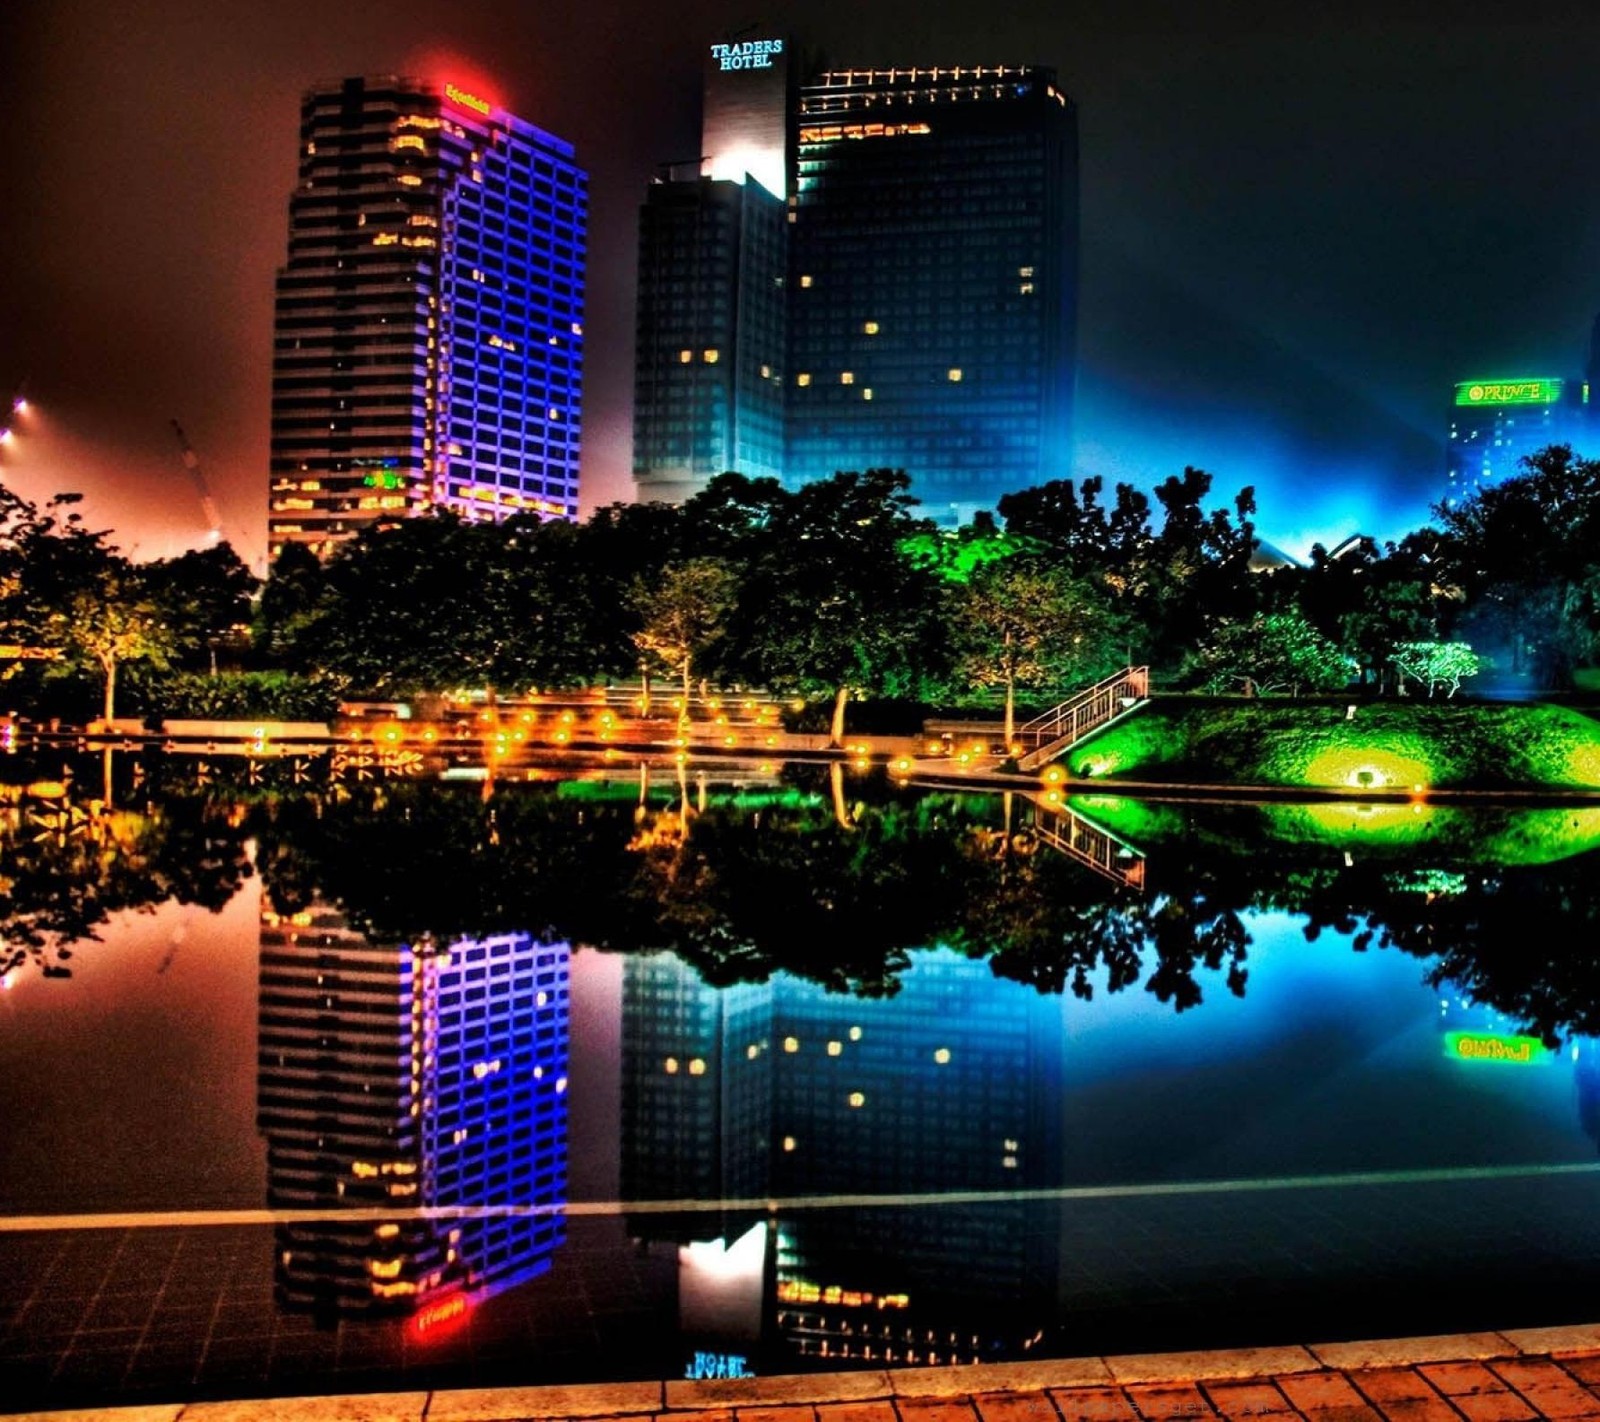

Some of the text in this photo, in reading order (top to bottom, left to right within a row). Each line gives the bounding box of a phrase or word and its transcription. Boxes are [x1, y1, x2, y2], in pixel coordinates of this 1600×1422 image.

[710, 39, 783, 58] TRADERS
[720, 54, 773, 71] HOTEL
[1484, 384, 1540, 400] PRINCE
